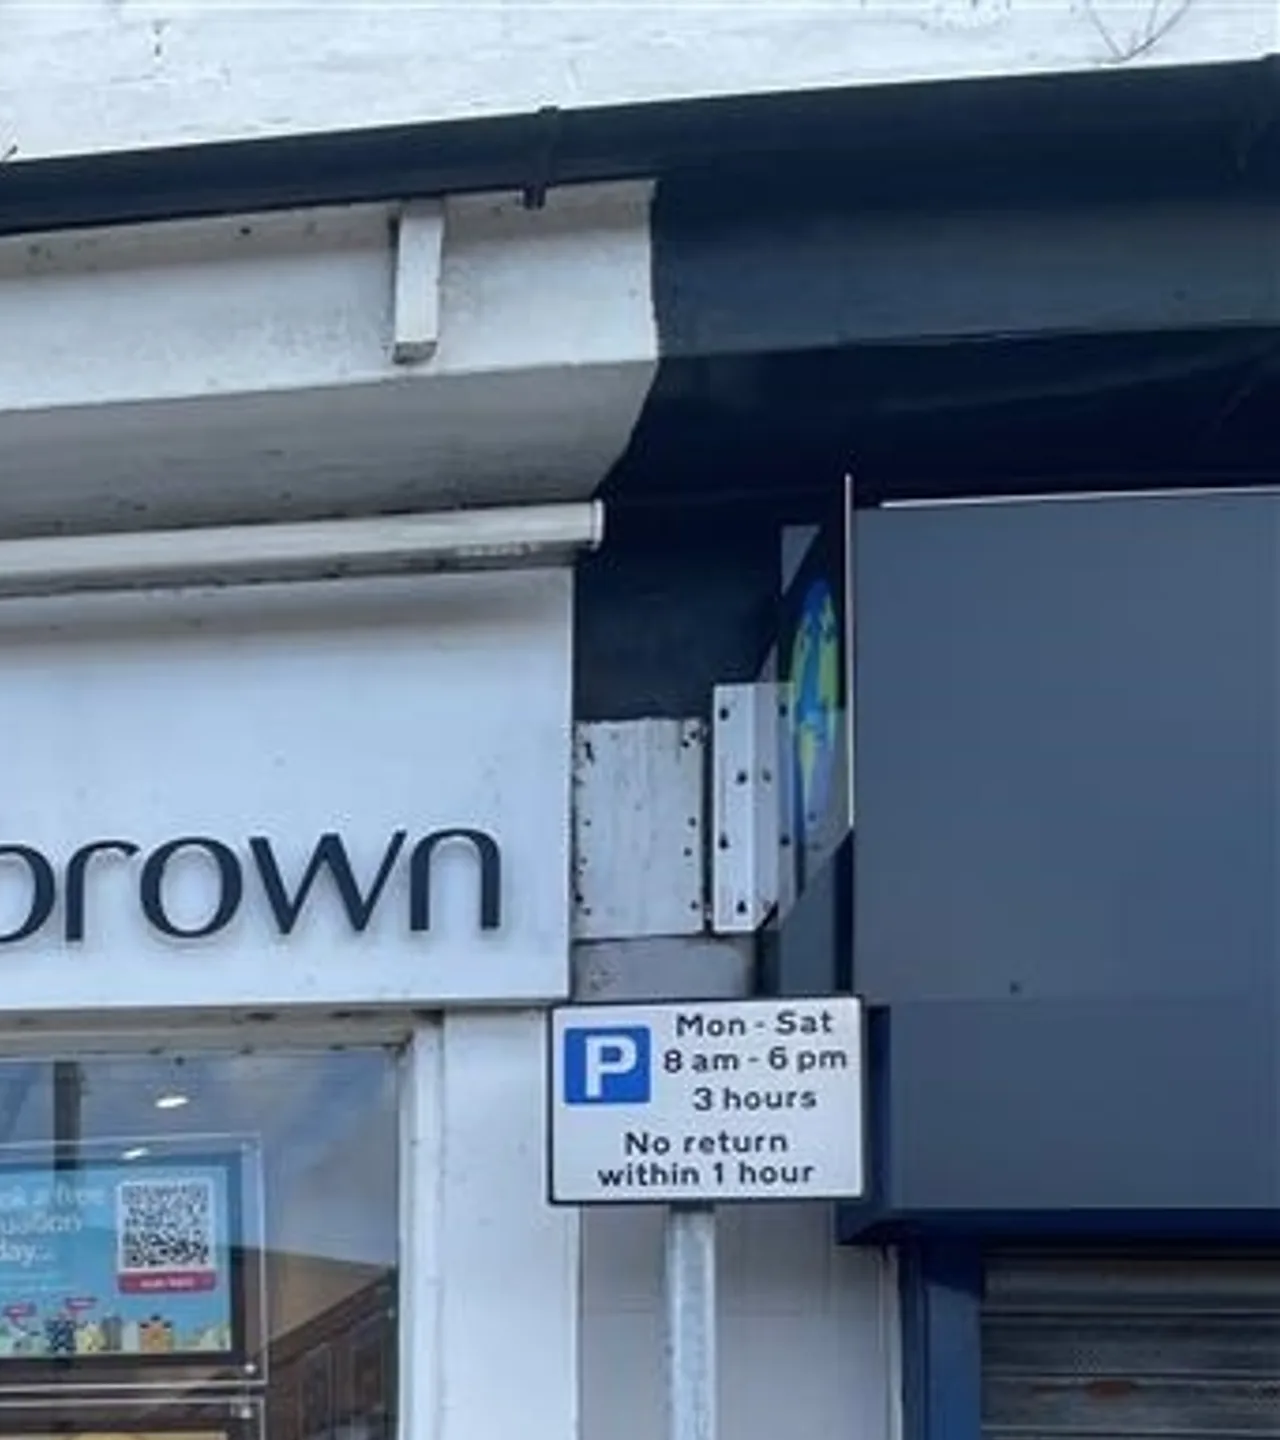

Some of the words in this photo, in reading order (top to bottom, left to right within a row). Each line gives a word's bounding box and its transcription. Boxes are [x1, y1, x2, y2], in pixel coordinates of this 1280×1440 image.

[585, 1036, 637, 1097] P
[694, 1087, 712, 1112] 3
[724, 1087, 817, 1111] hours
[625, 1132, 671, 1156] No
[683, 1131, 788, 1153] return
[597, 1162, 700, 1187] within
[713, 1163, 724, 1184] 1
[739, 1161, 814, 1185] hour
